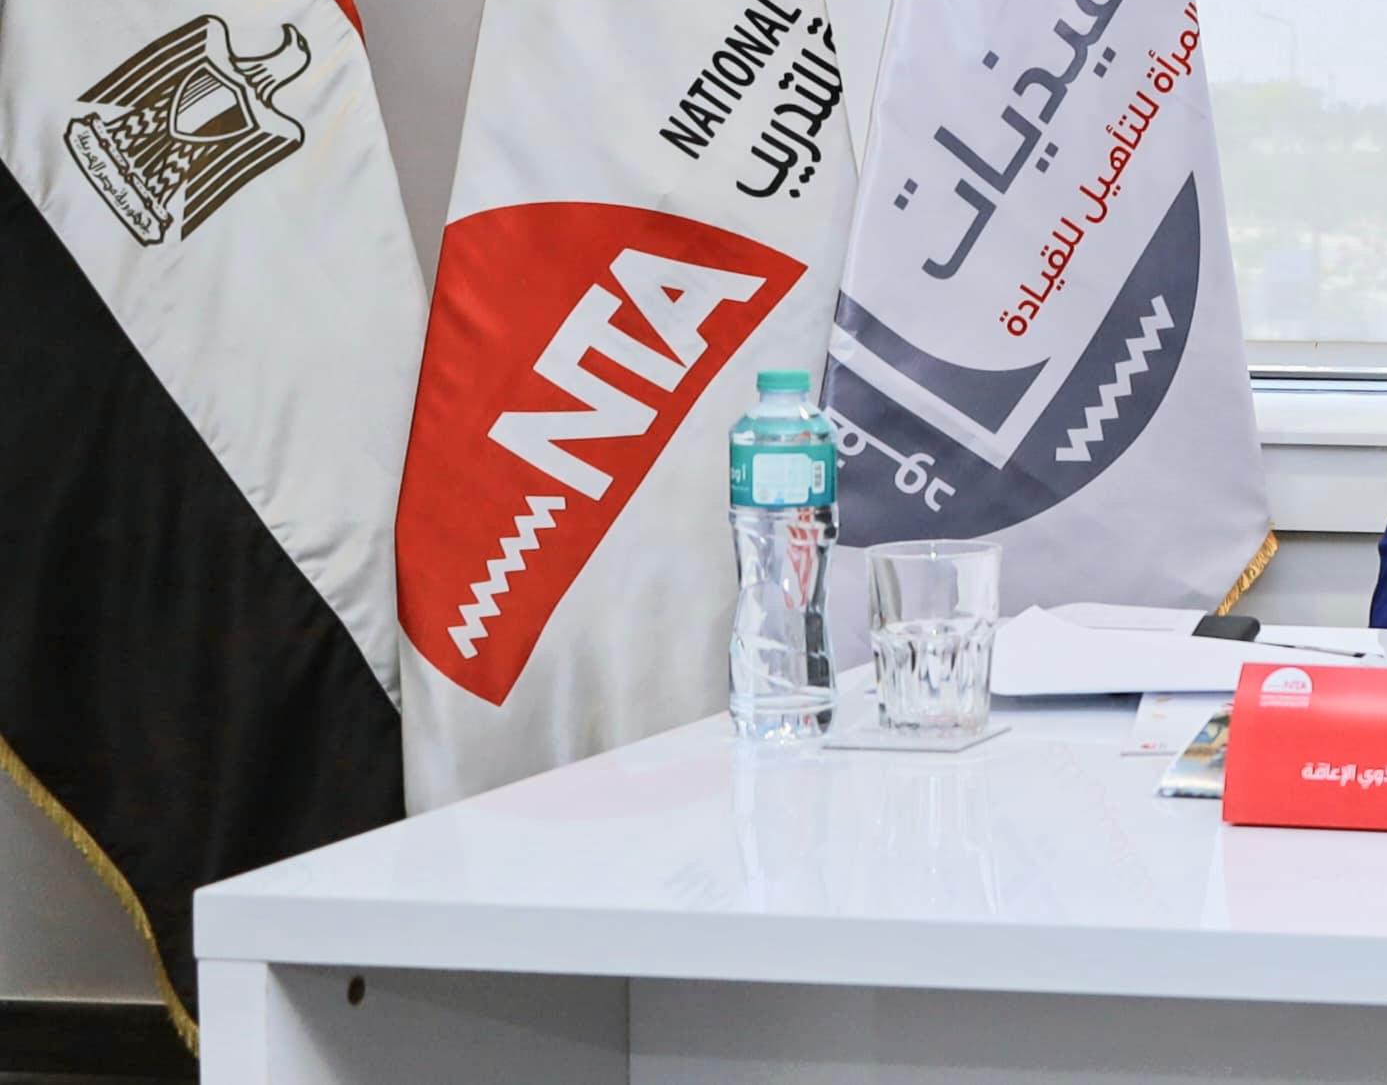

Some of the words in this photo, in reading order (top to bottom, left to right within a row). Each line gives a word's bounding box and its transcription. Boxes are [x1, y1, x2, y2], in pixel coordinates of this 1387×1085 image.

[736, 48, 843, 198] للتدريب
[1079, 91, 1160, 225] للتأهيل
[999, 217, 1085, 337] للقيادة
[487, 248, 767, 502] NTA
[824, 405, 956, 513] قود
[1301, 761, 1357, 787] الإعاقة
